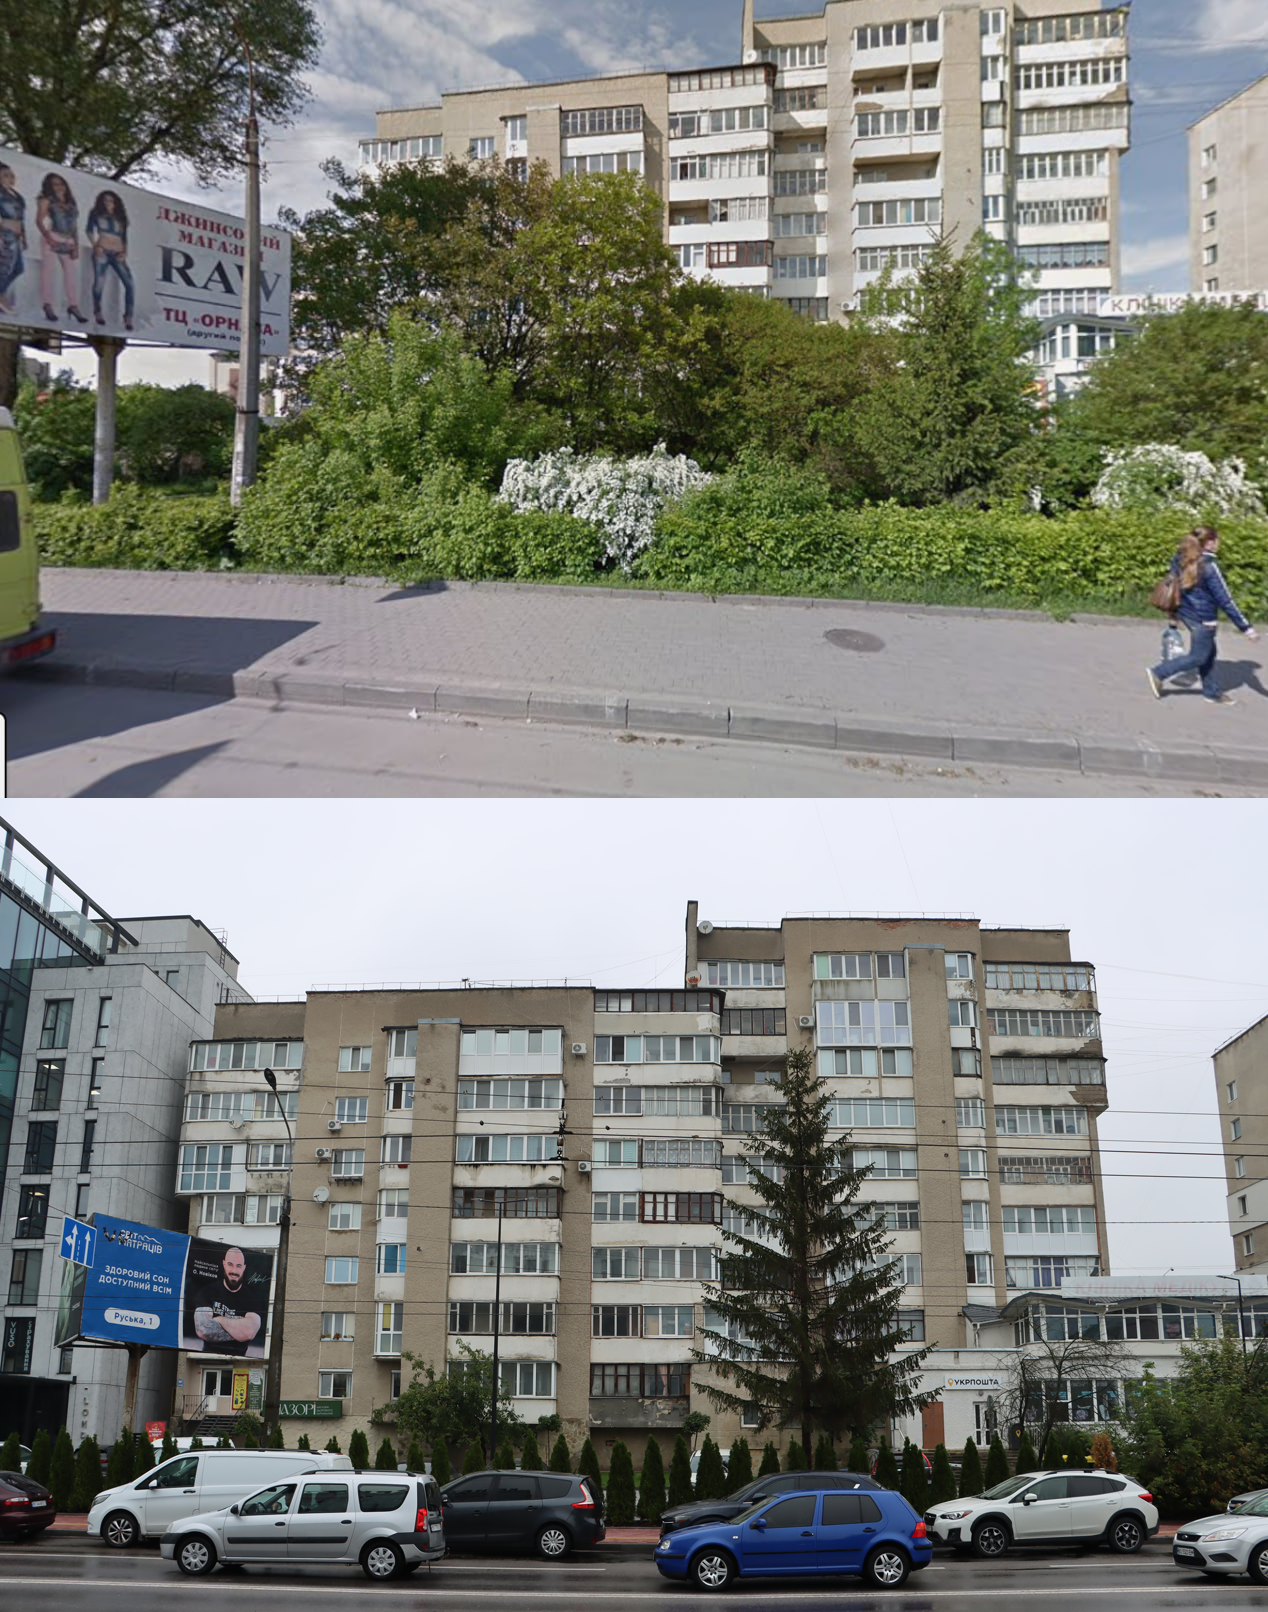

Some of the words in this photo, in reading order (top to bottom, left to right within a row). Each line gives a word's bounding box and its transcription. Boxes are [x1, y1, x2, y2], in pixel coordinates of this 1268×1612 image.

[156, 205, 280, 250] ДЖИНСОИЙ
[178, 229, 264, 262] МАГАЗ
[156, 244, 282, 302] RAW
[163, 307, 188, 327] ТЦ
[193, 313, 279, 337] «ОРНА»
[98, 1274, 151, 1291] ДОСТУПНИЙ
[152, 1285, 172, 1295] ВСІМ
[104, 1265, 151, 1281] ЗДОРОВИЙ
[152, 1274, 170, 1284] СОН
[114, 1312, 146, 1326] Руська,
[149, 1317, 153, 1325] 1
